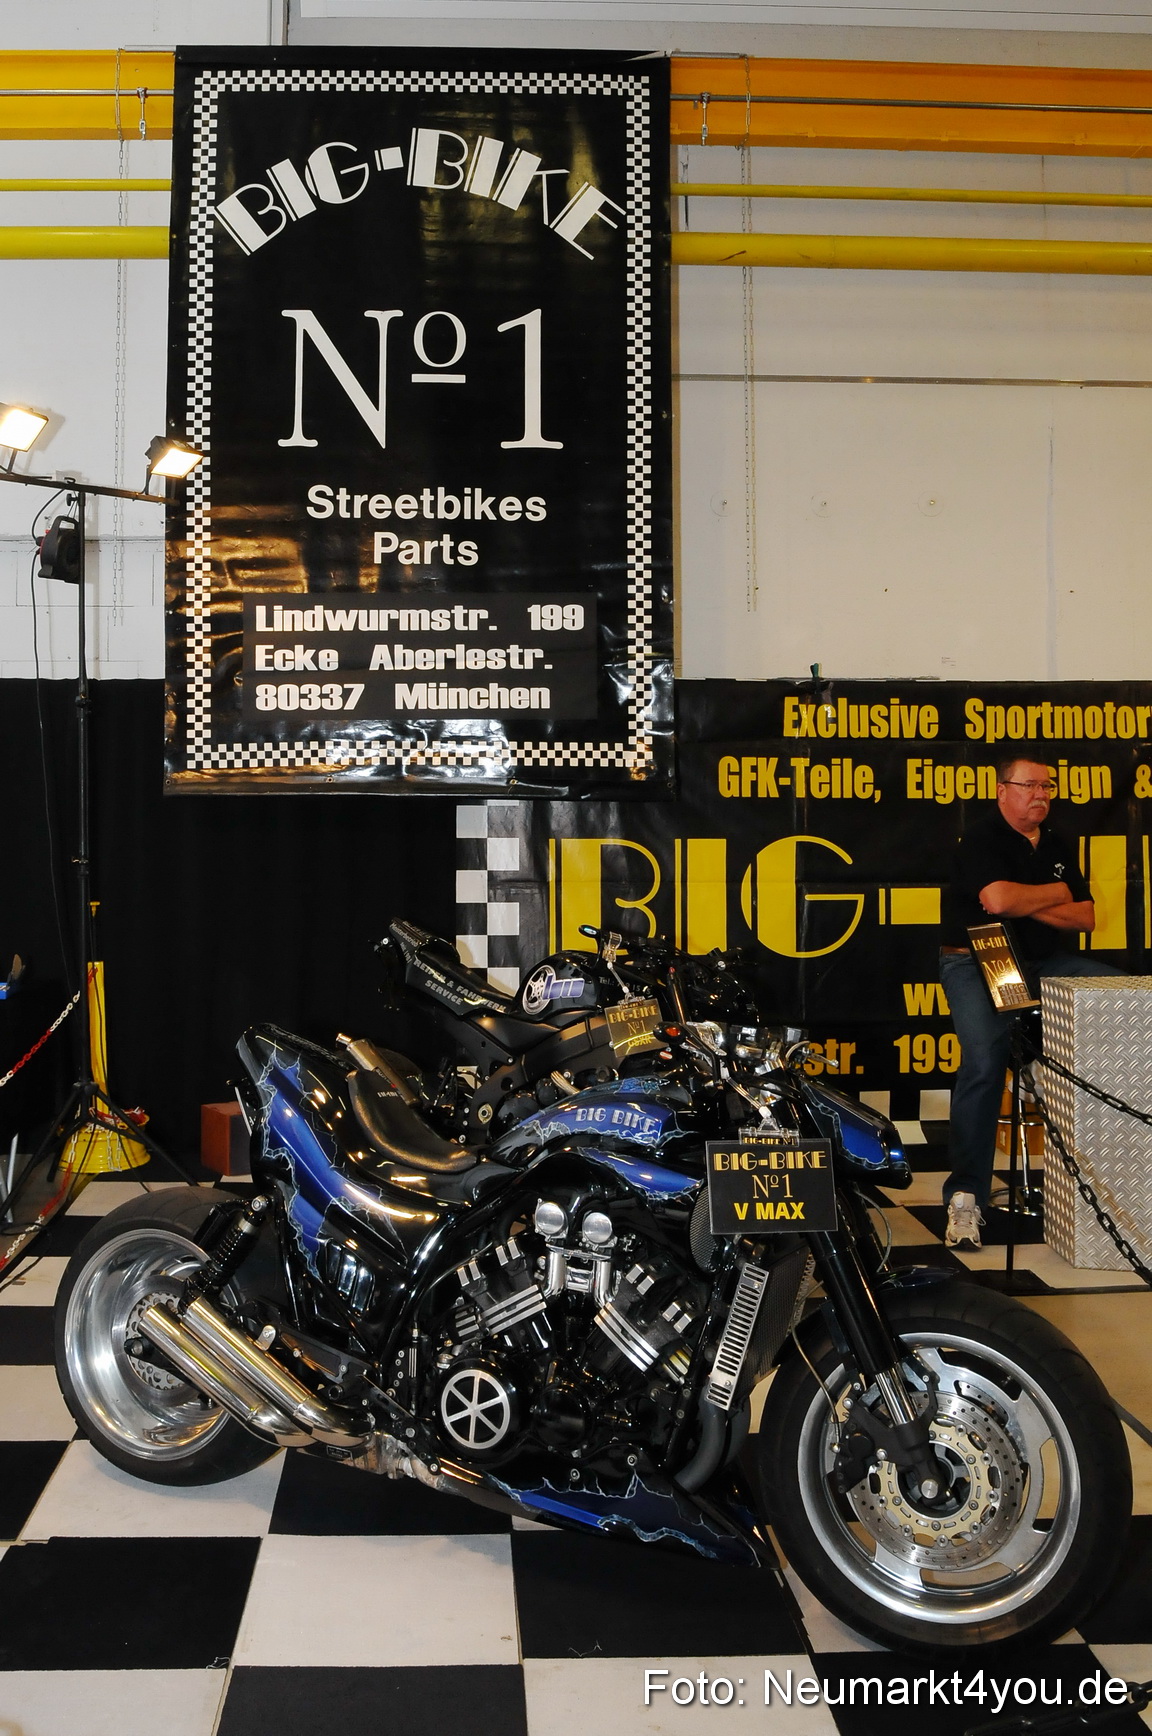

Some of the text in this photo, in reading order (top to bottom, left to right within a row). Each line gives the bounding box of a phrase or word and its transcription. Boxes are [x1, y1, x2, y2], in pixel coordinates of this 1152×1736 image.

[212, 127, 627, 260] BIG-BIKE
[306, 484, 547, 521] Streetbikes
[373, 531, 479, 566] Parts
[255, 604, 585, 632] Lindwurmstr. 199
[255, 643, 553, 672] Ecke Aberlestr.
[255, 682, 551, 711] 80337 München
[783, 697, 1152, 743] Exclusive Sportmotor
[718, 756, 1152, 805] GFK-Teile, Eigensign &
[971, 935, 1009, 951] BIG-BIKE
[413, 960, 507, 1014] REIFEN & FAHRWERK
[424, 979, 464, 1006] SERVICE
[608, 1005, 658, 1024] BIG-BIKE
[796, 1033, 961, 1076] str. 199
[575, 1107, 656, 1133] BIG BIKE
[713, 1150, 828, 1171] BIG-BIKE
[734, 1202, 805, 1220] V MAX
